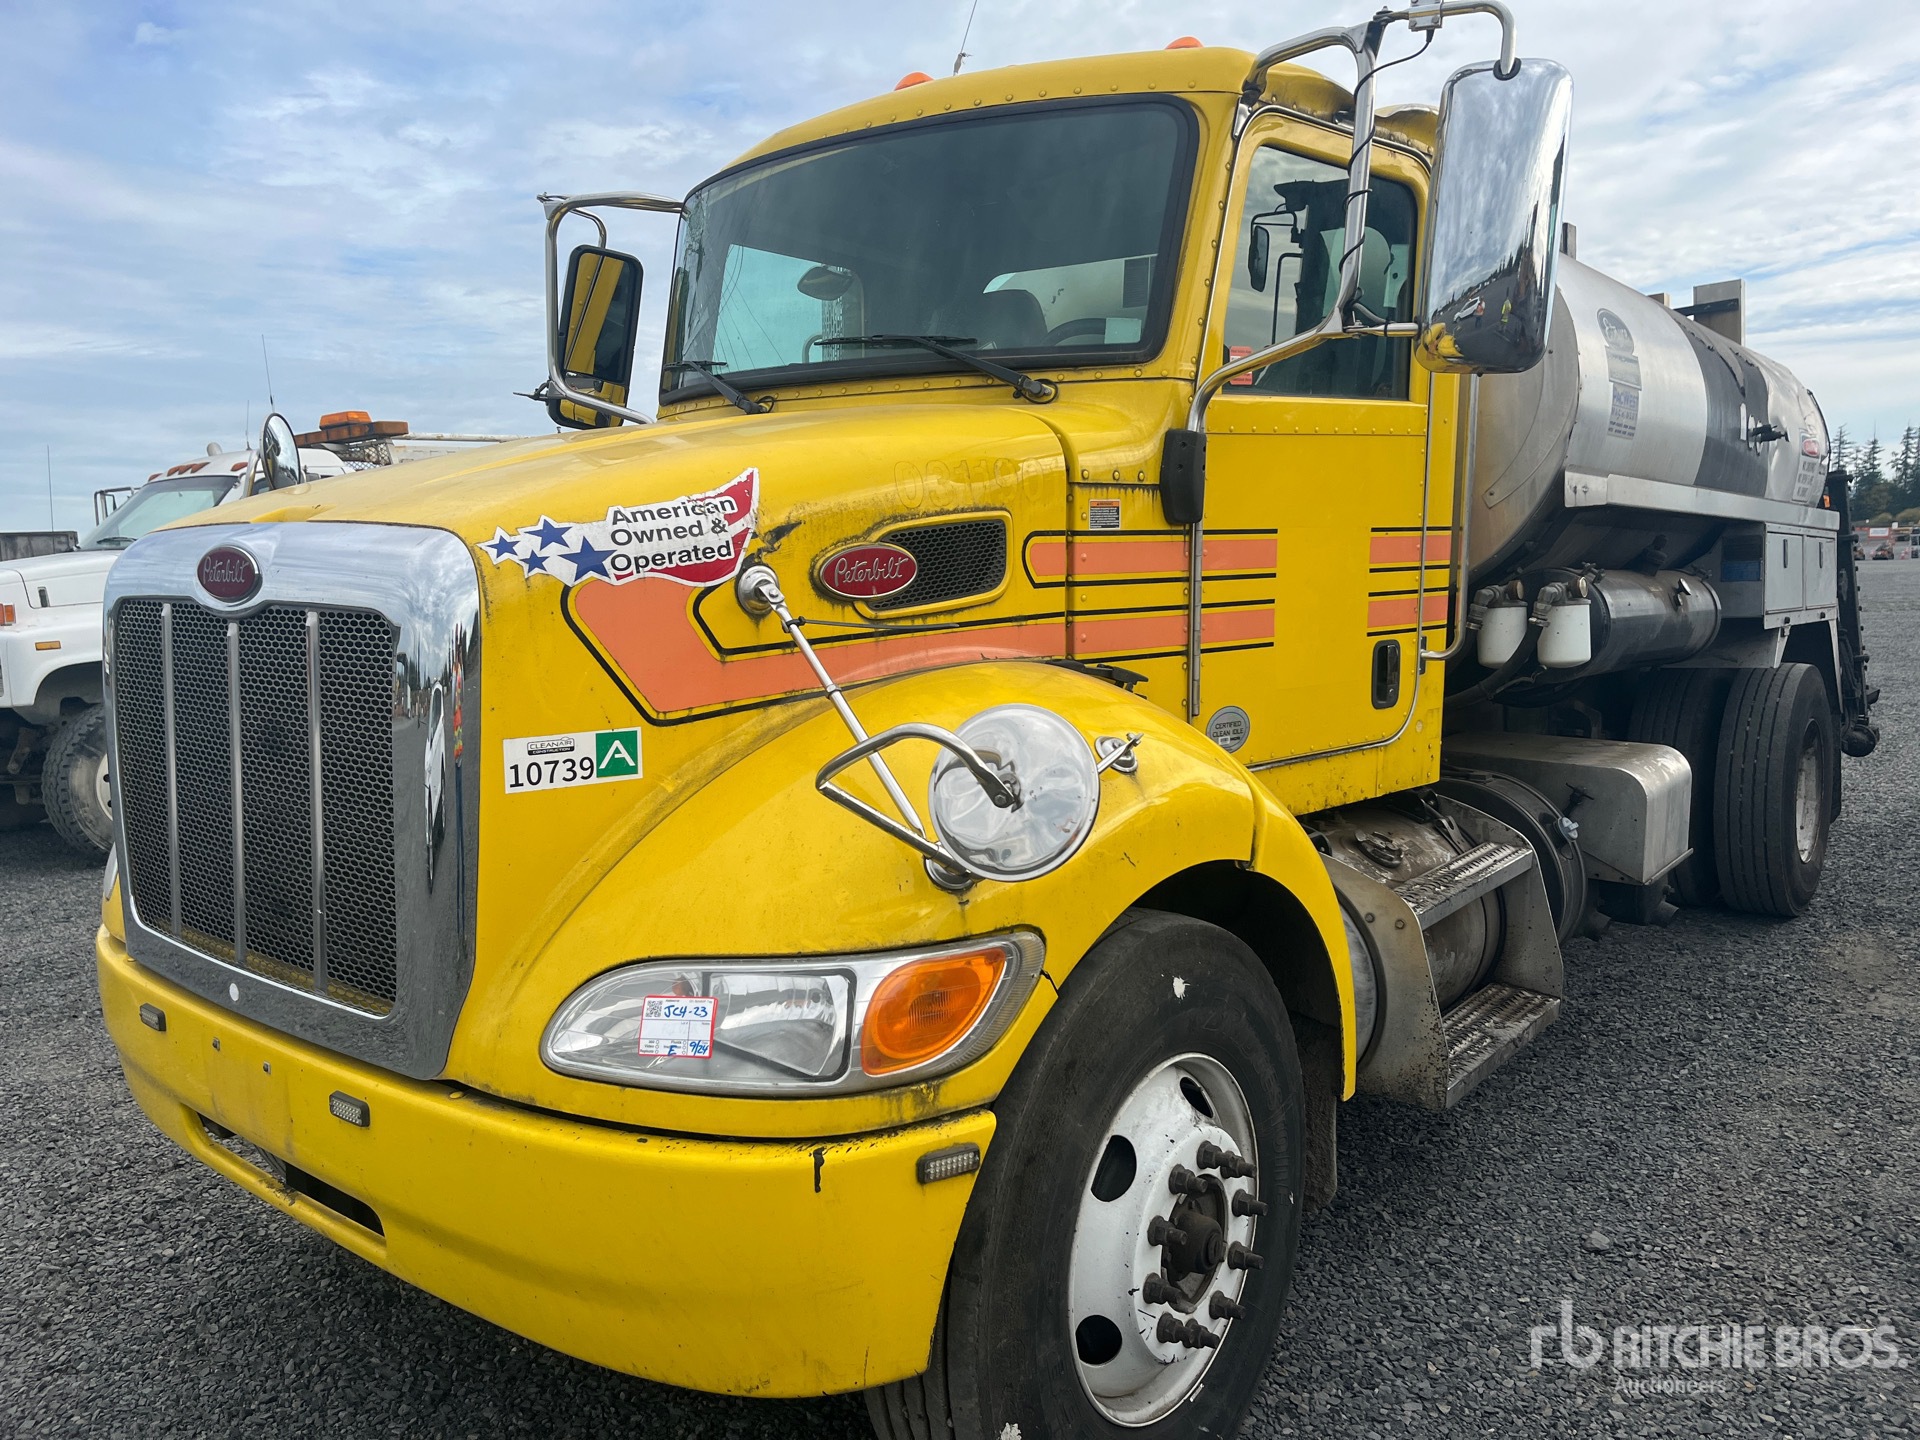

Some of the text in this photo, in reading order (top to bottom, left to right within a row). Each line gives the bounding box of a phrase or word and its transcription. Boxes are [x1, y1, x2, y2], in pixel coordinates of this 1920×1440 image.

[611, 497, 737, 526] American
[610, 518, 729, 546] Owned &
[203, 556, 250, 585] Peterbilt
[610, 541, 733, 573] Operated
[834, 557, 909, 587] Peterbilt
[1212, 730, 1230, 738] CLEAN
[1215, 720, 1242, 730] CERTIFIED
[599, 739, 636, 769] A
[509, 756, 595, 788] 10739
[668, 1045, 678, 1057] E
[689, 1040, 709, 1056] 9/24
